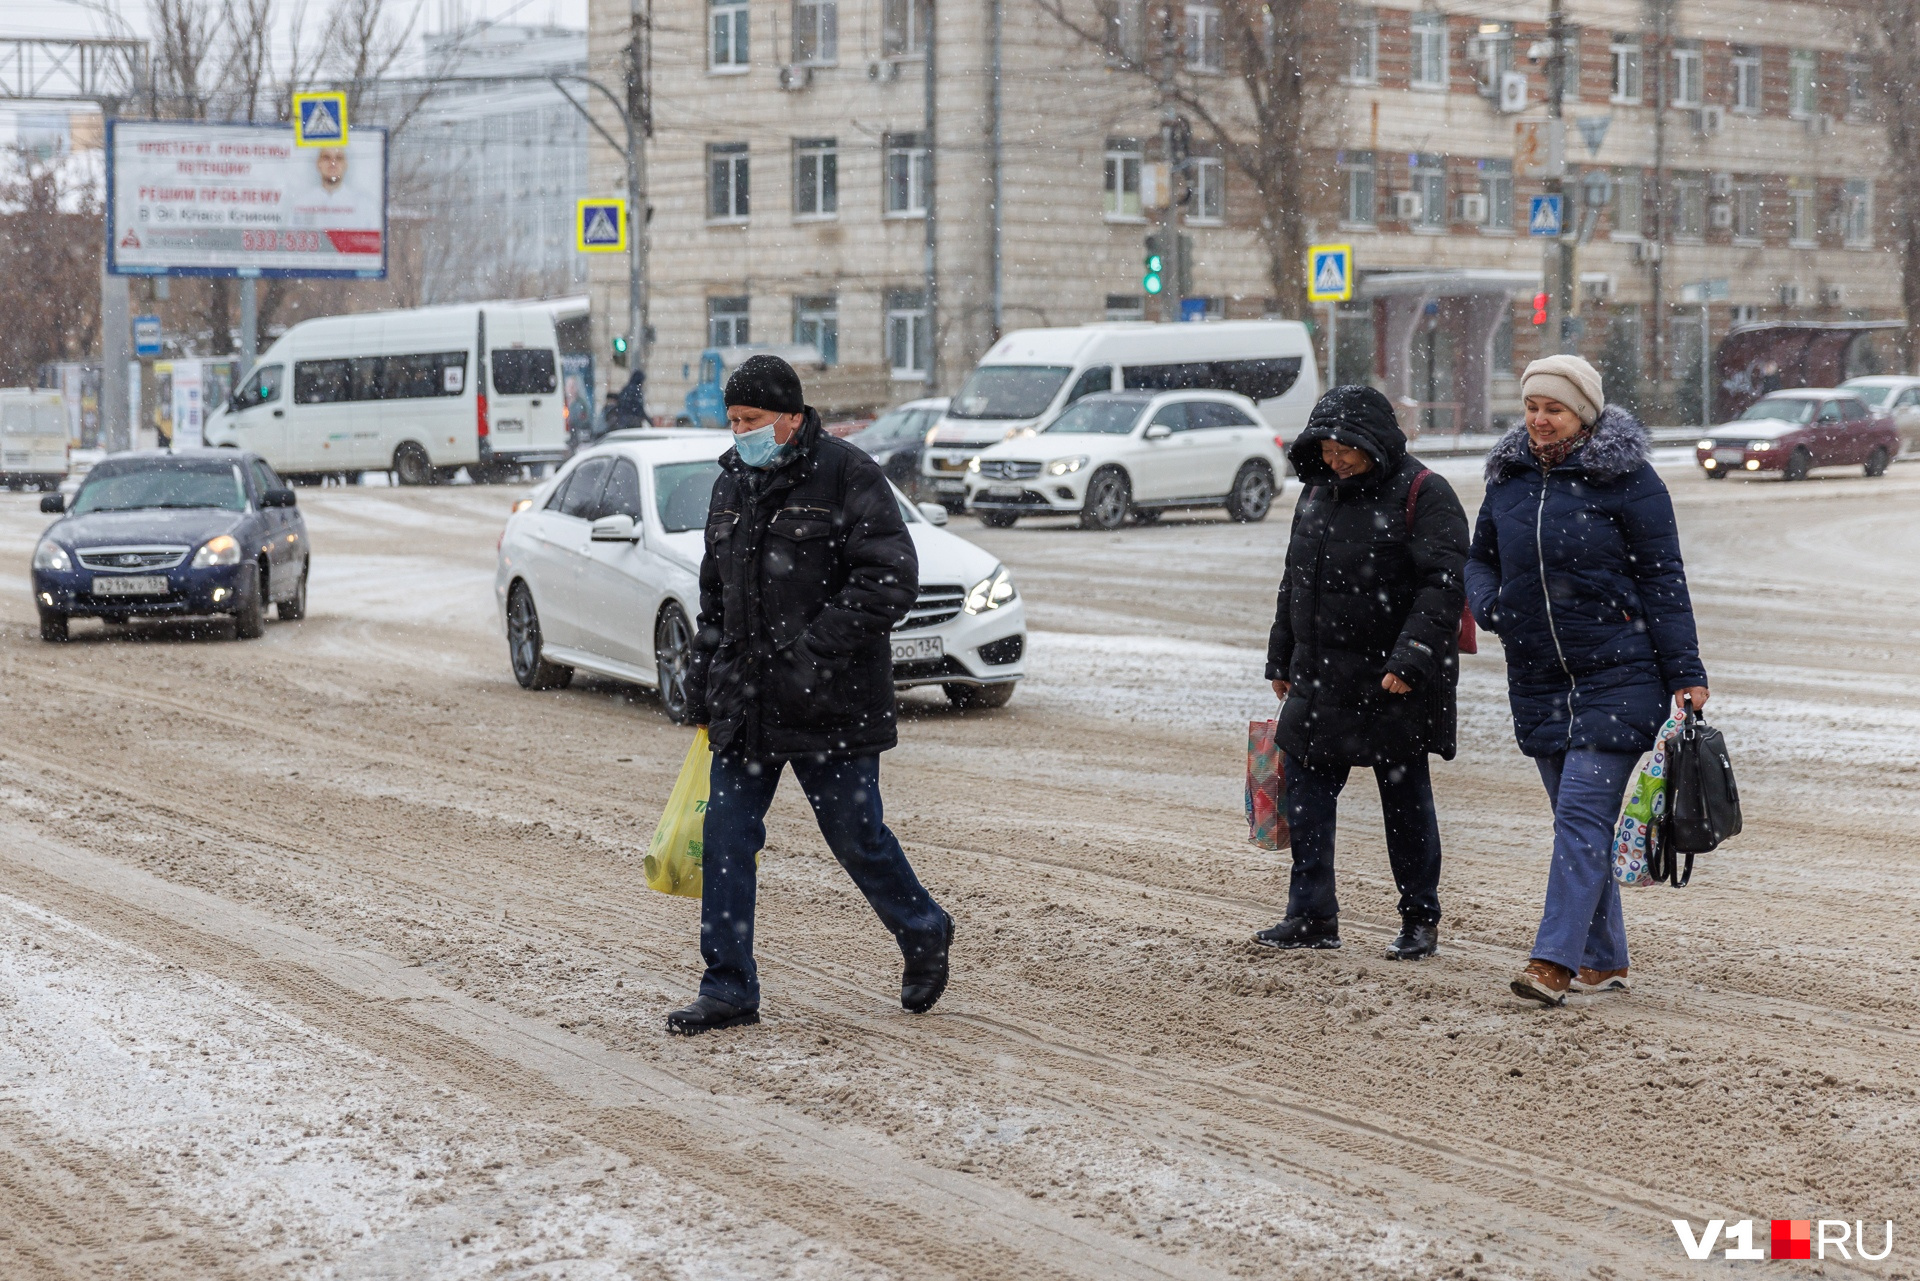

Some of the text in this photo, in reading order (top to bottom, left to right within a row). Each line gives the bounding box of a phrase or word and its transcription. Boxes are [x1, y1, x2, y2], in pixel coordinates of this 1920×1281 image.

[139, 186, 282, 204] РЕШИМ ПРОБЛЕМУ
[918, 639, 940, 652] 134
